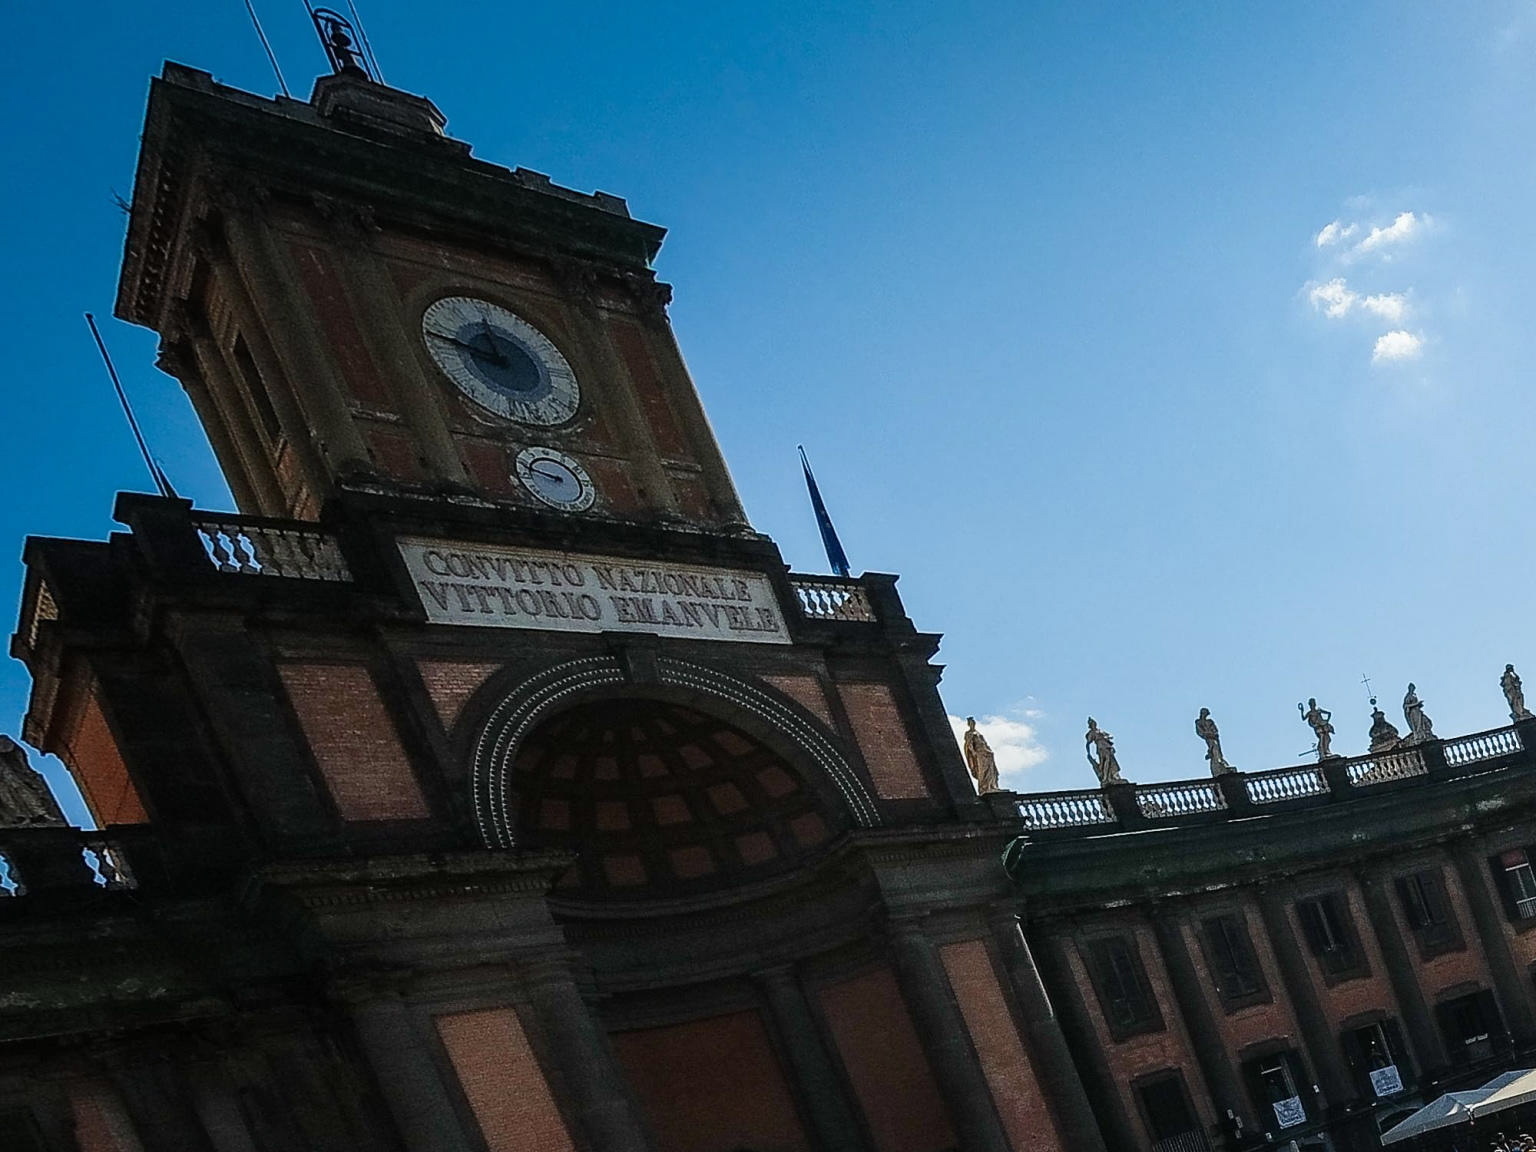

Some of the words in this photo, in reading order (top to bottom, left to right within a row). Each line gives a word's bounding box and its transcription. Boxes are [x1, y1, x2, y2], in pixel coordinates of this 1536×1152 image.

[423, 550, 585, 587] CONVITTO
[591, 566, 753, 602] NAZIONALE
[418, 580, 601, 621] VITTORIO
[609, 596, 780, 633] EMANVELE
